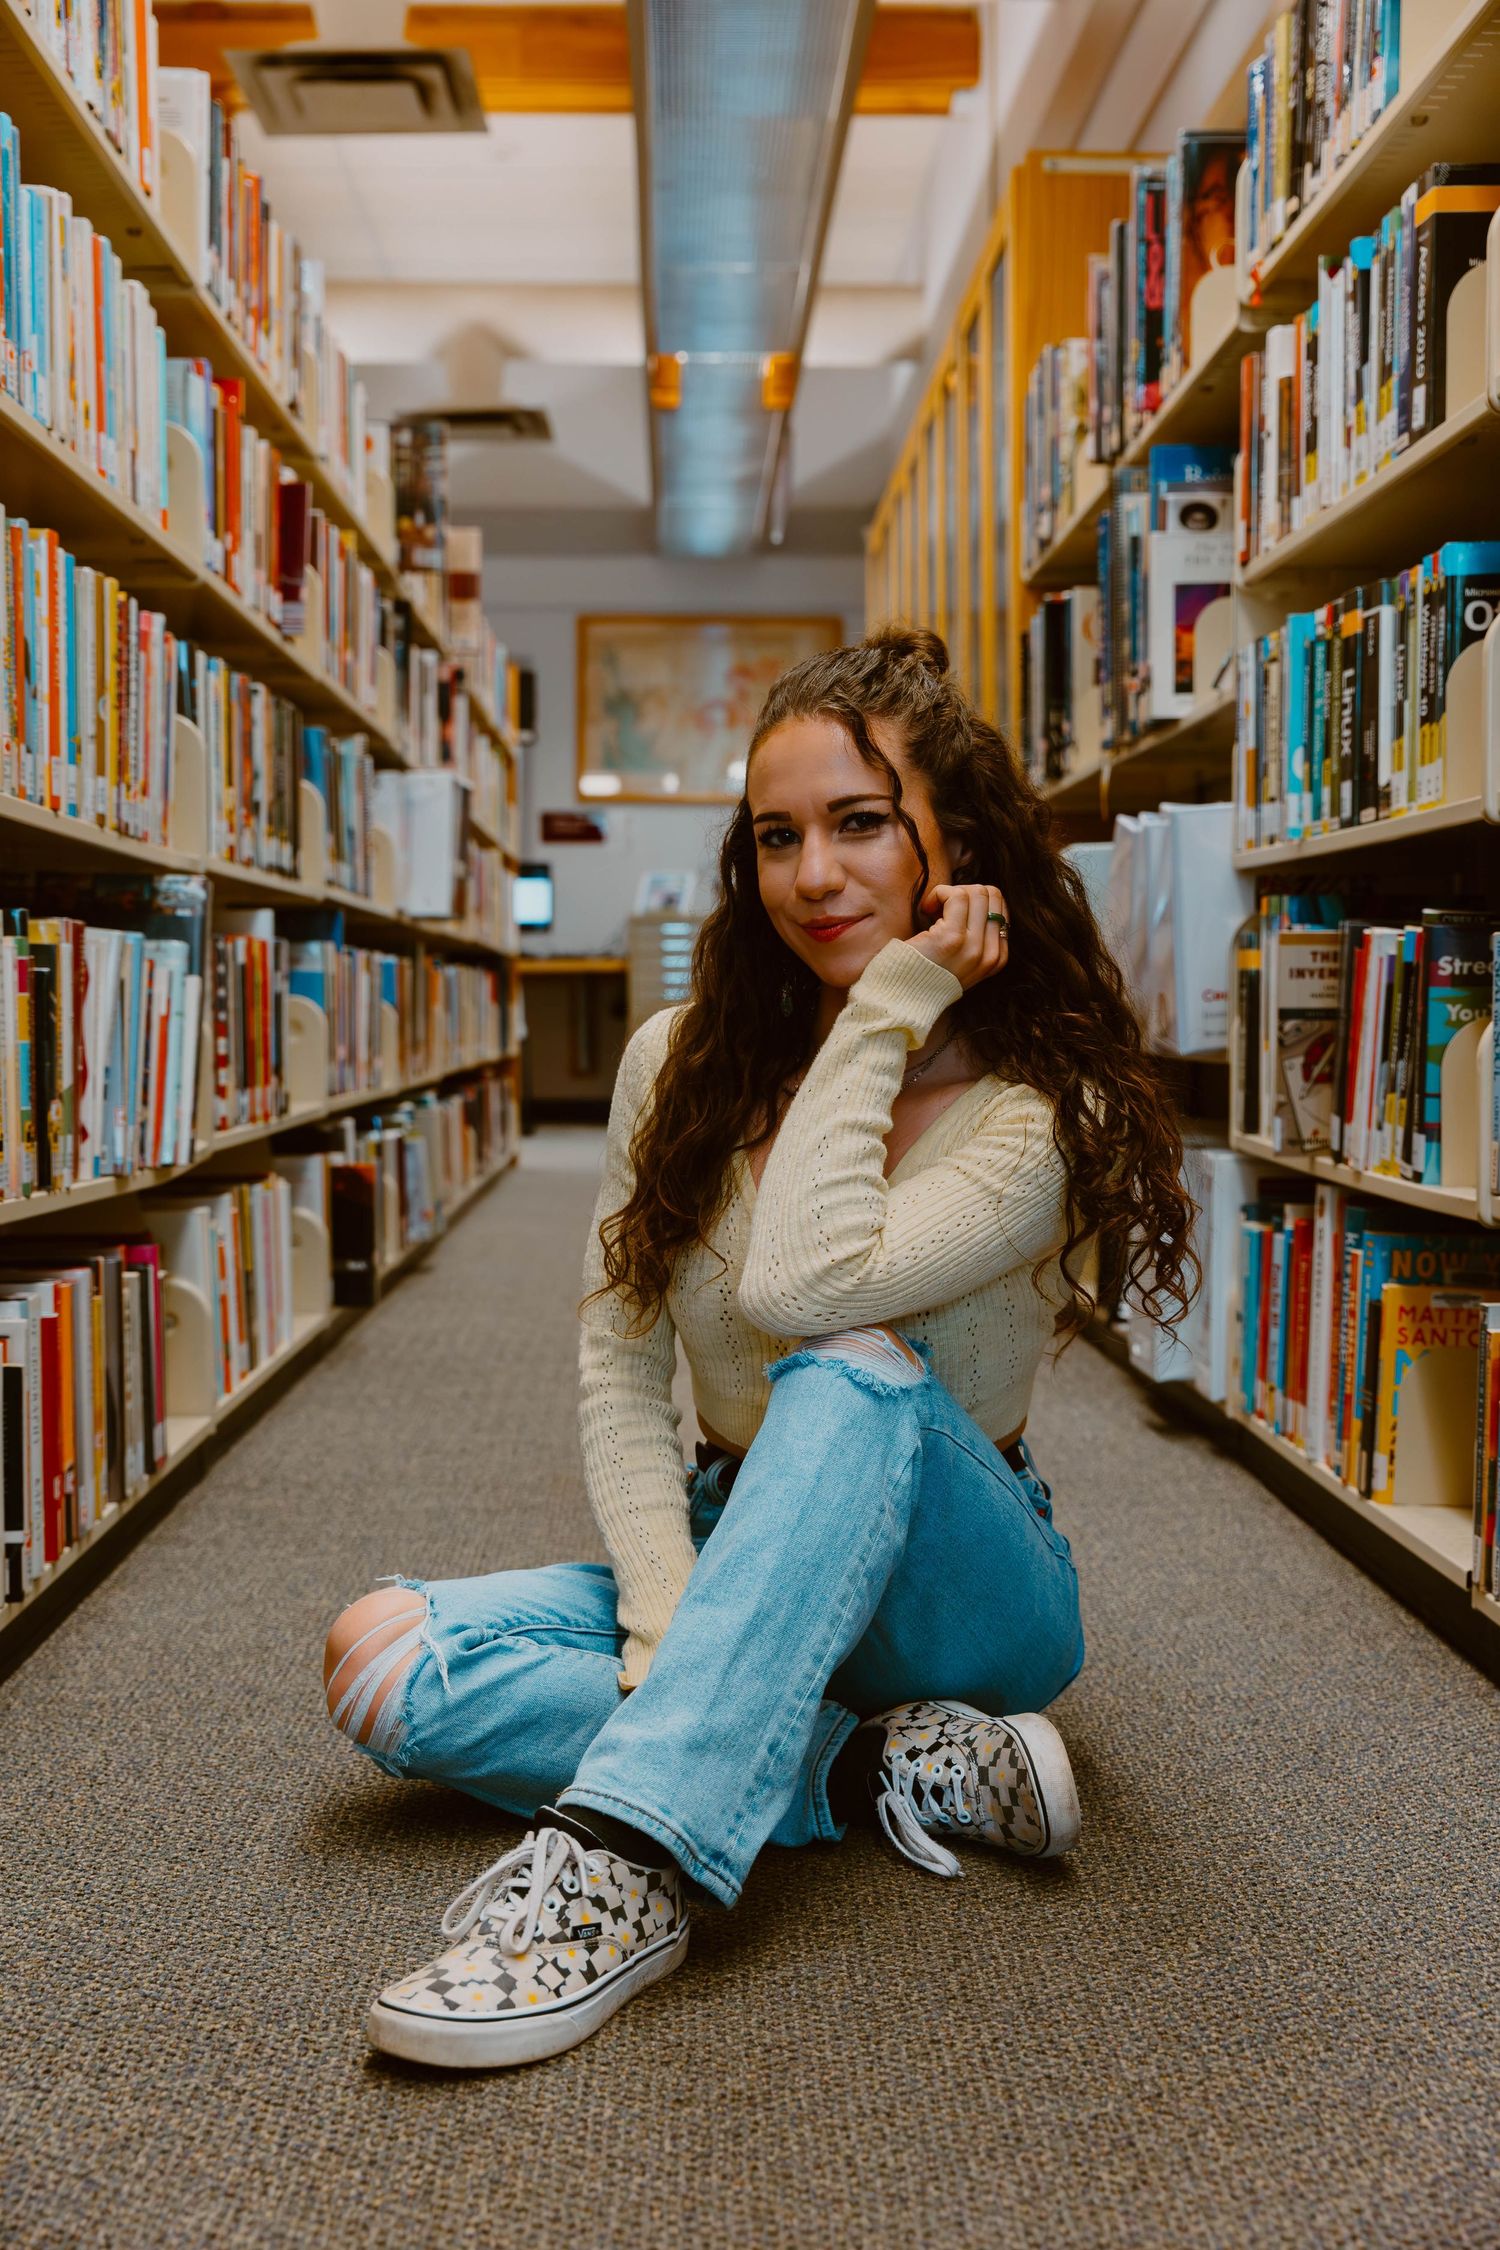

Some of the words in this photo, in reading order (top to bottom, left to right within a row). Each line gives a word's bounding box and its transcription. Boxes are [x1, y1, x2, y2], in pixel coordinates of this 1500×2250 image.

[1416, 245, 1429, 322] Access
[1415, 325, 1428, 379] 2019
[1463, 600, 1496, 632] O
[1340, 668, 1356, 757] Linux
[577, 1926, 597, 1939] VANS
